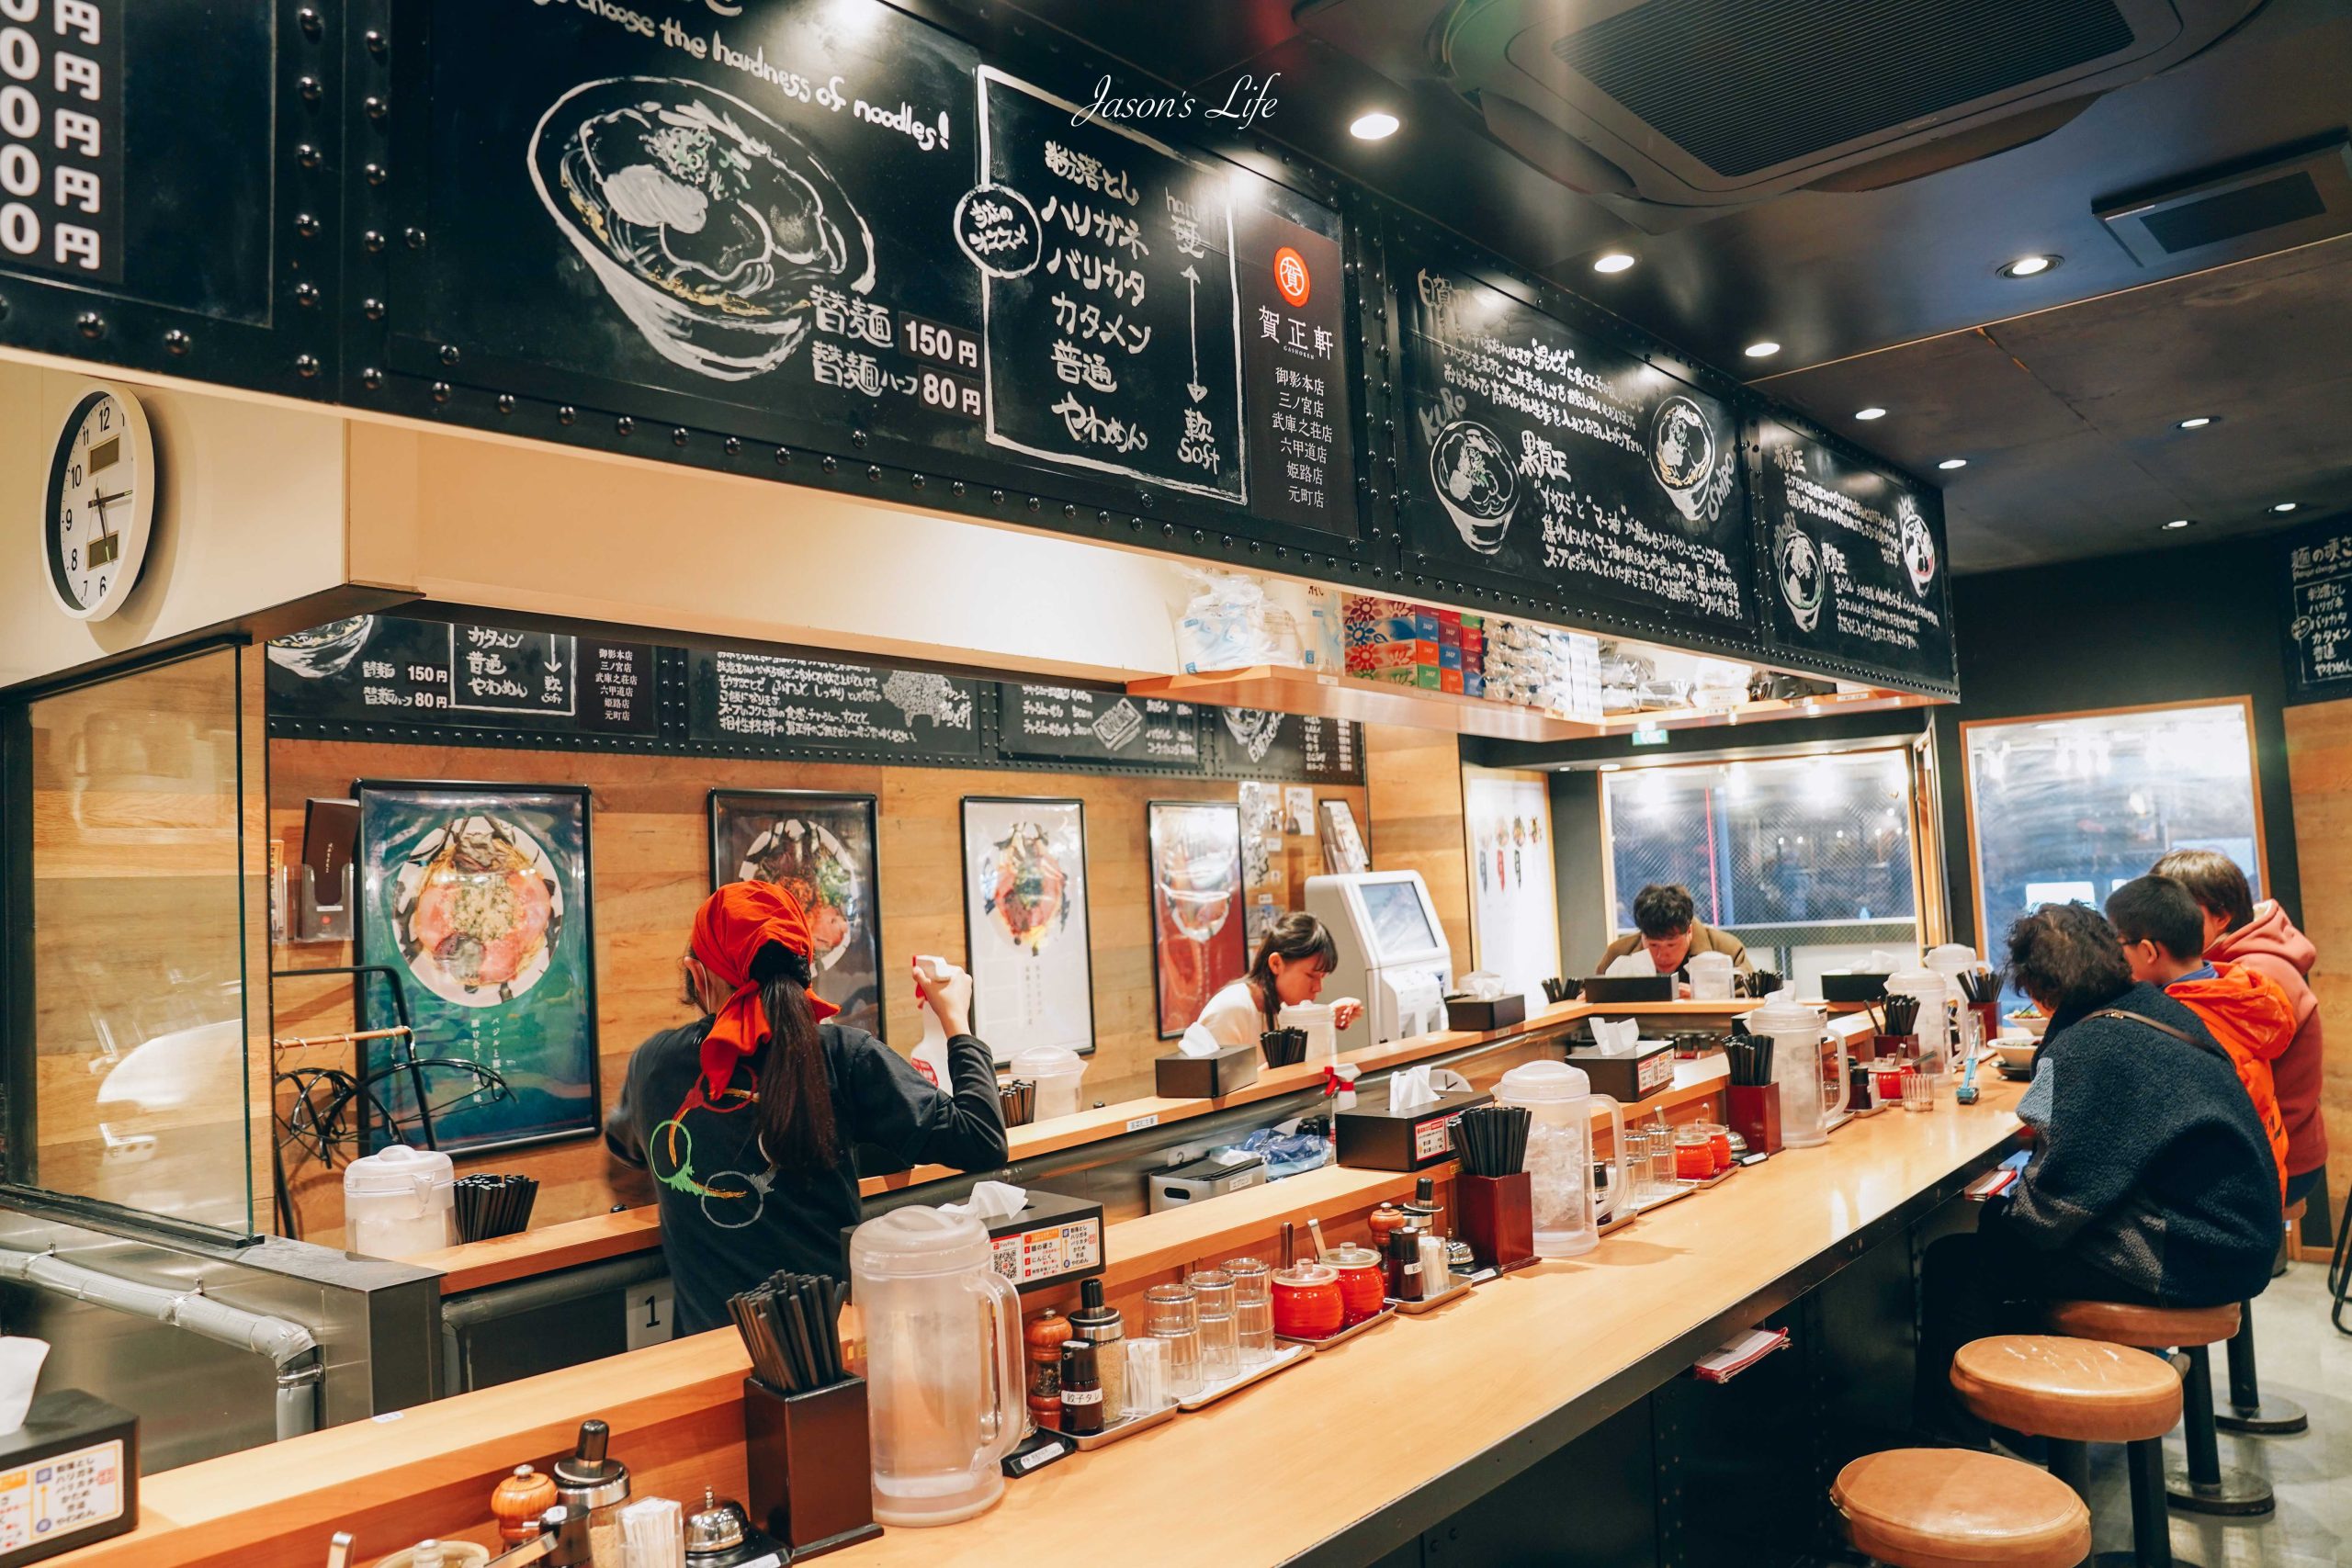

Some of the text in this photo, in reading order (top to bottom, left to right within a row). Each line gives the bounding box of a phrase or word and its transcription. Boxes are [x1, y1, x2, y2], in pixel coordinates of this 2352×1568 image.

[659, 17, 707, 60] the
[712, 30, 811, 104] hardness
[815, 75, 845, 111] of
[853, 101, 950, 152] noodles!
[1045, 141, 1139, 207] 粉落とし
[1041, 195, 1149, 260] ハリガネ
[1046, 248, 1146, 307] バリカタ
[809, 284, 978, 368] 替麺 150円
[1051, 291, 1152, 355] カタメン
[1258, 305, 1335, 362] 賀正軒
[811, 340, 981, 416] 替麺ハーフ 80円
[1051, 338, 1118, 394] 普通
[1274, 367, 1326, 397] 御影本店
[98, 406, 111, 432] 12
[1278, 391, 1325, 419] 三ノ宮店
[1051, 391, 1148, 453] やわめん
[1183, 408, 1216, 444] 軟
[82, 429, 90, 446] 11
[1280, 439, 1328, 465] 六甲道店
[1518, 429, 1572, 483] 黒賀正
[71, 464, 82, 489] 10
[1286, 460, 1324, 486] 姫路店
[1288, 486, 1325, 509] 元町店
[65, 508, 73, 532] 9
[71, 548, 78, 571] 8
[83, 580, 88, 597] 7
[467, 626, 525, 649] カタメン
[407, 665, 448, 682] 150円
[467, 676, 528, 698] やわめん
[414, 692, 448, 709] 80円
[645, 1294, 661, 1328] 1
[1066, 1393, 1100, 1404] 餃子タレ
